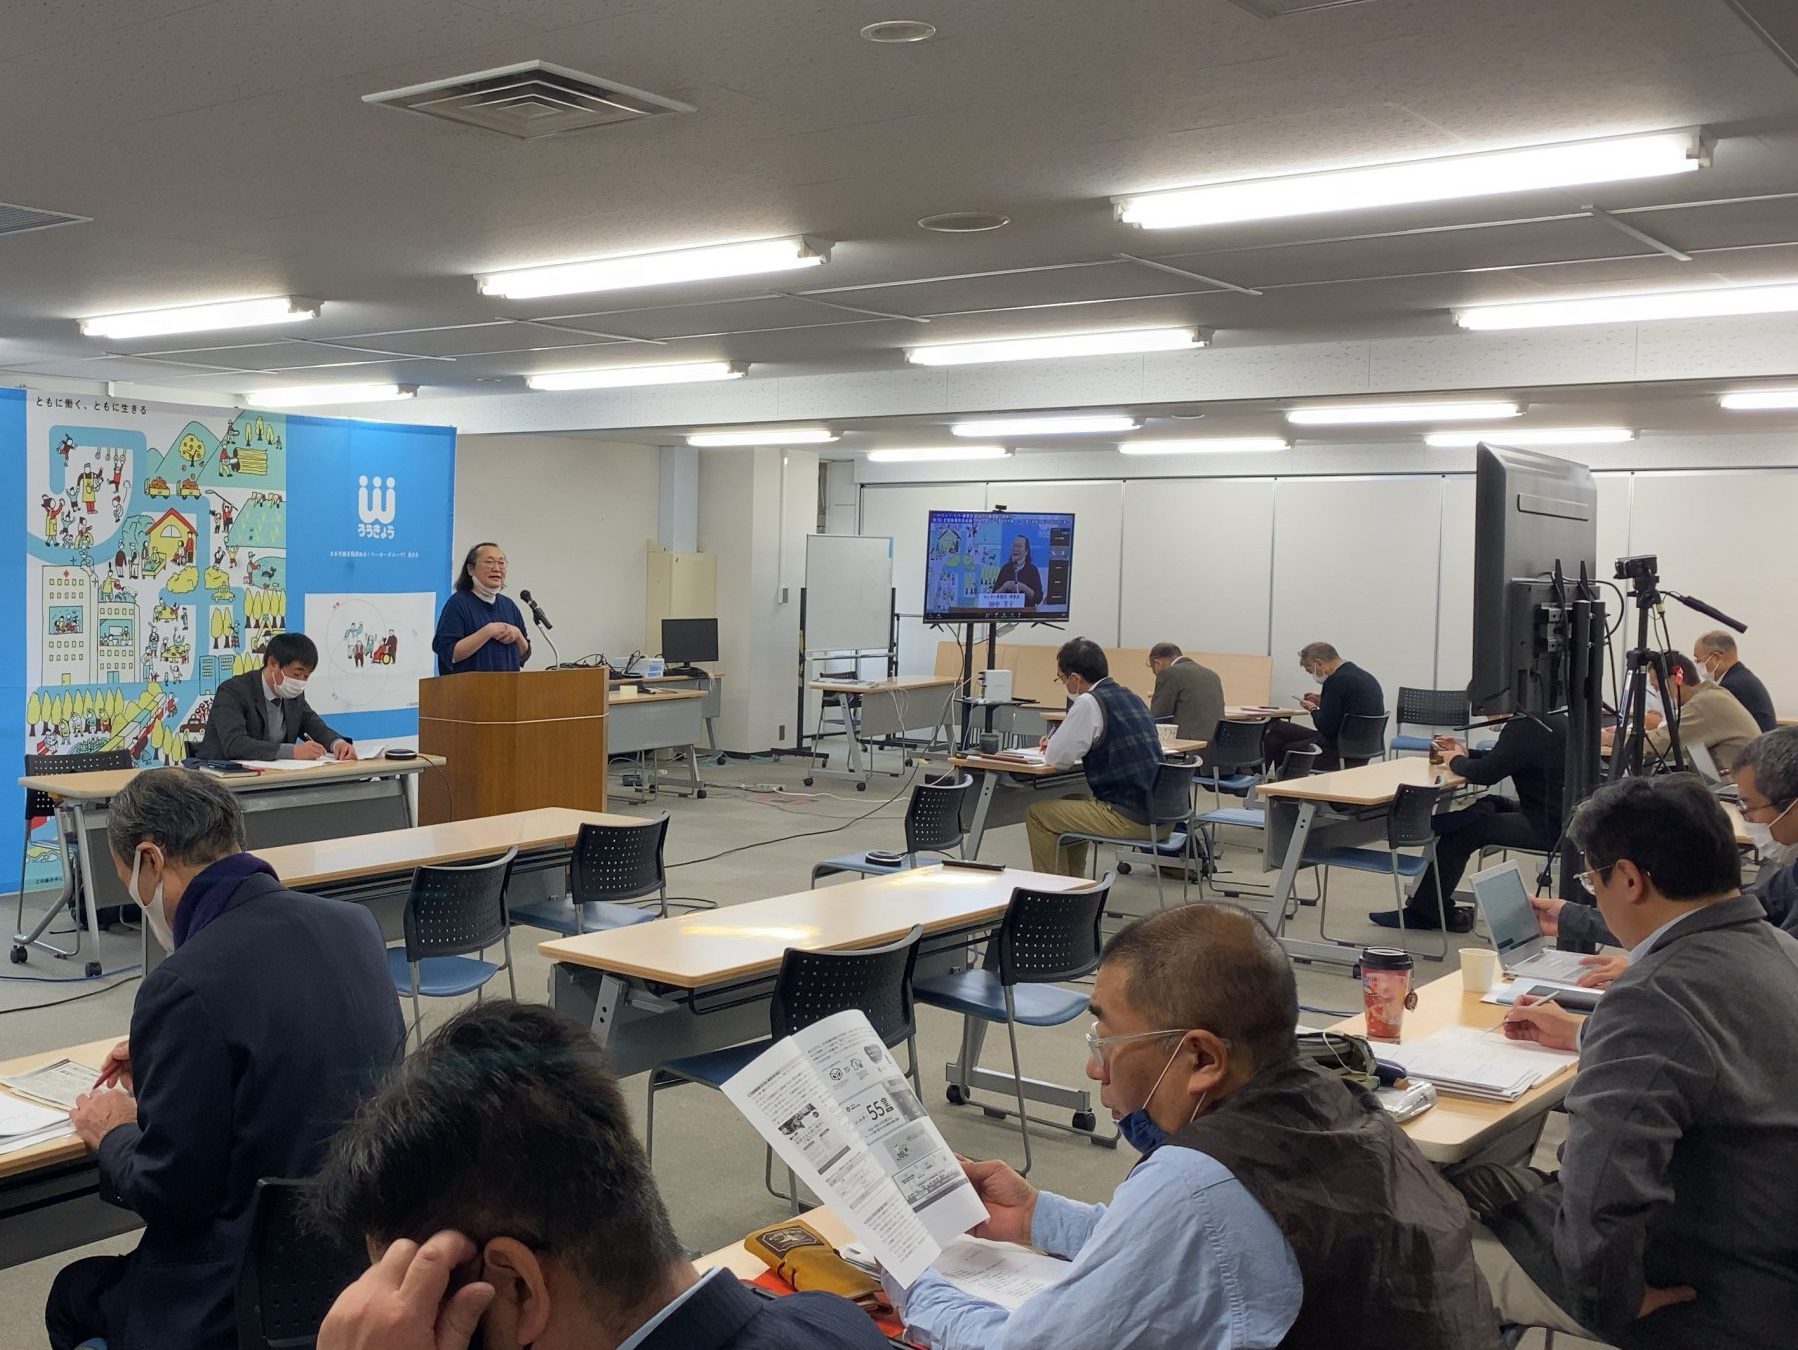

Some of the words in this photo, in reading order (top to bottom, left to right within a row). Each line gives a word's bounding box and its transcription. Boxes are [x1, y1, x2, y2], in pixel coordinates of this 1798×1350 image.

[36, 396, 147, 415] ともに働く、ともに生きる
[358, 523, 395, 539] ろうきょう
[866, 1101, 884, 1120] 55
